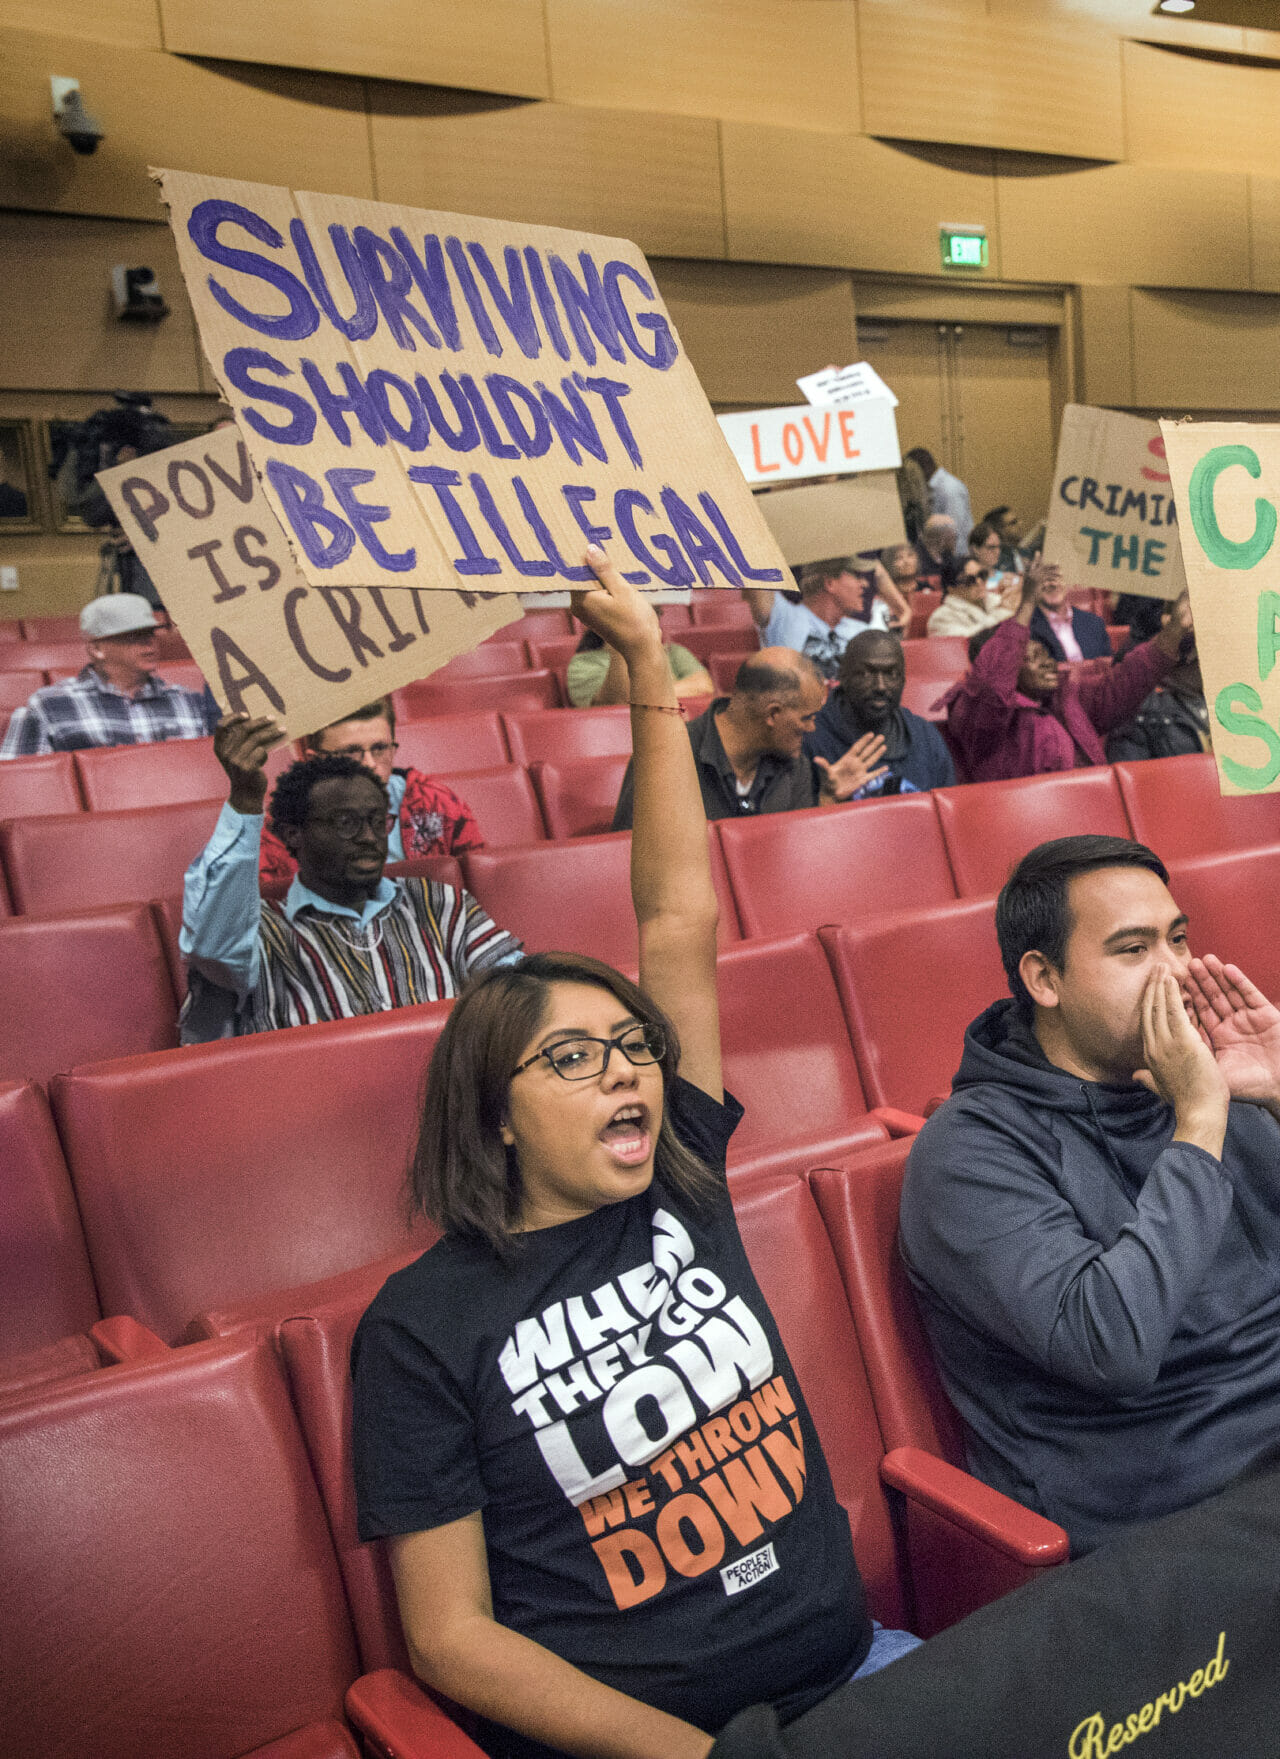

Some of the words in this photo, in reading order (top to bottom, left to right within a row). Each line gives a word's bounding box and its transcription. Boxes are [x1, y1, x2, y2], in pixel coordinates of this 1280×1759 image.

[187, 198, 678, 371] SURVIVING
[750, 410, 861, 474] LOVE
[187, 524, 282, 604] IS
[266, 457, 417, 572] BE
[407, 464, 785, 589] ILLEGAL
[1080, 526, 1168, 577] THE
[211, 626, 286, 715] A
[497, 1207, 695, 1394] WHEN
[510, 1322, 655, 1429] THEY
[658, 1267, 728, 1337] GO
[534, 1294, 774, 1507] LOW
[577, 1477, 656, 1538] WE
[649, 1375, 798, 1493] THROW
[591, 1415, 808, 1612] DOWN
[738, 1561, 771, 1588] ACTION
[1068, 1631, 1231, 1759] Reserved
